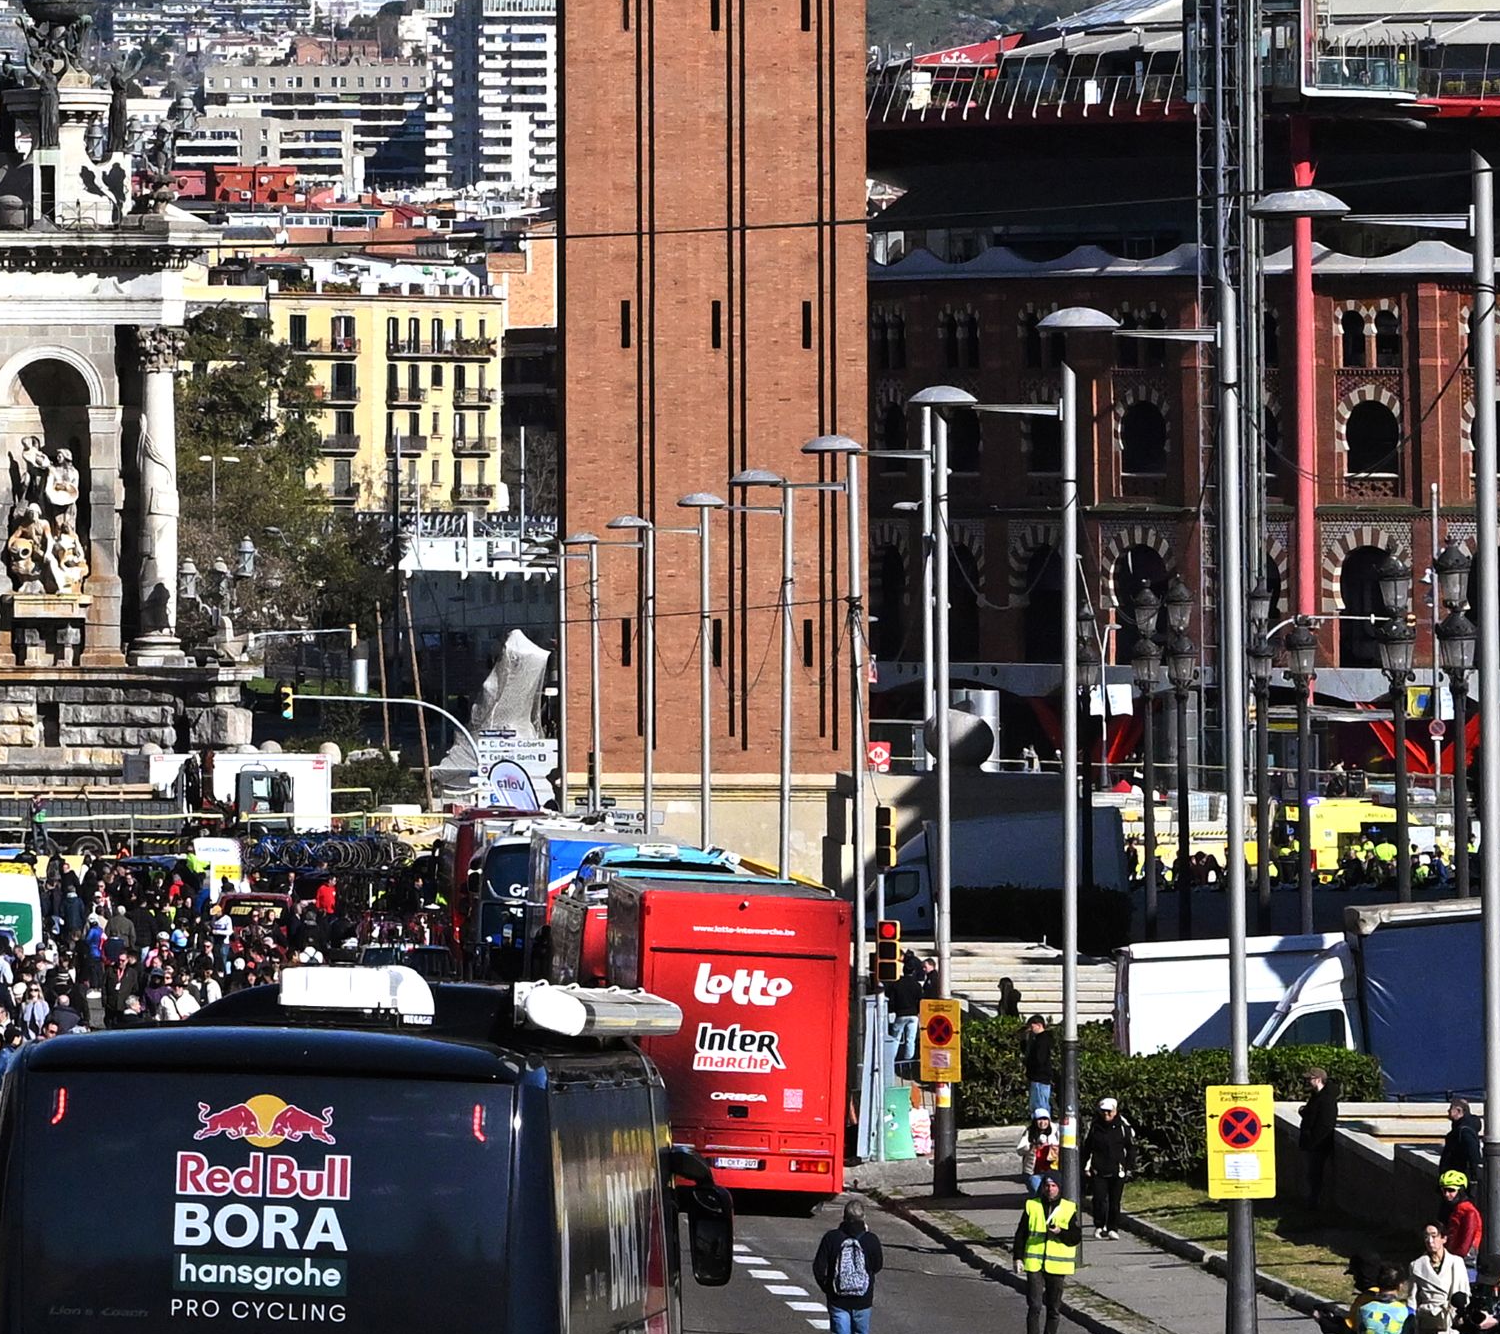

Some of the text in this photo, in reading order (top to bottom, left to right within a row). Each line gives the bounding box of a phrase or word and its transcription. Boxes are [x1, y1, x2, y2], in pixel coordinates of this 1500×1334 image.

[173, 1202, 349, 1251] BORA
[179, 1253, 342, 1291] hansgrohe
[171, 1298, 347, 1323] PRO CYCLING
